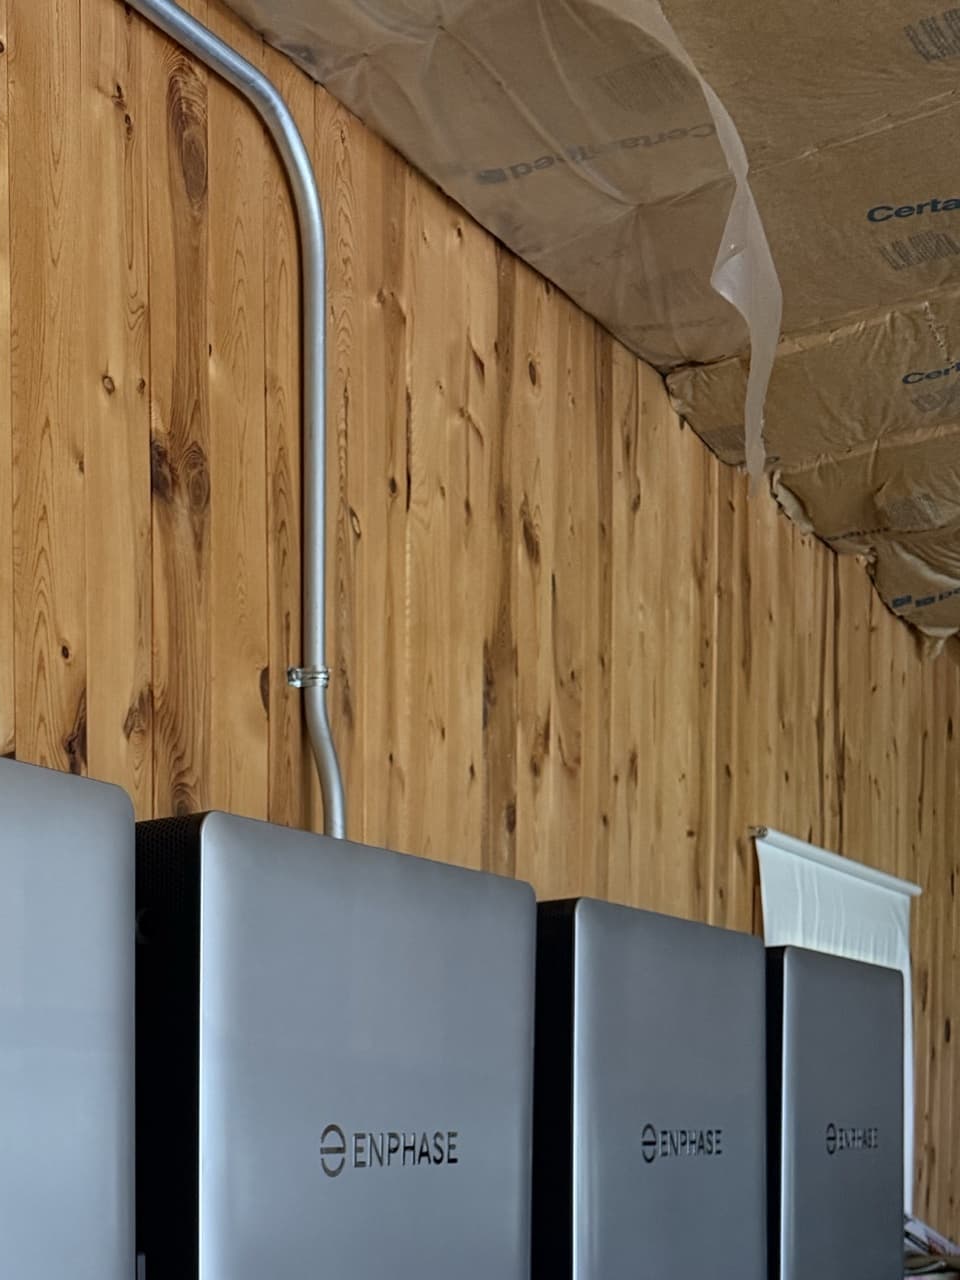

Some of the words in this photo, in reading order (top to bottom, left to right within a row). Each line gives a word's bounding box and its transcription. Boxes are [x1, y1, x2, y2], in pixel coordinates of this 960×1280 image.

[352, 1131, 459, 1169] ENPHASE
[659, 1128, 723, 1158] ENPHASE
[837, 1127, 879, 1151] ENPHASE
